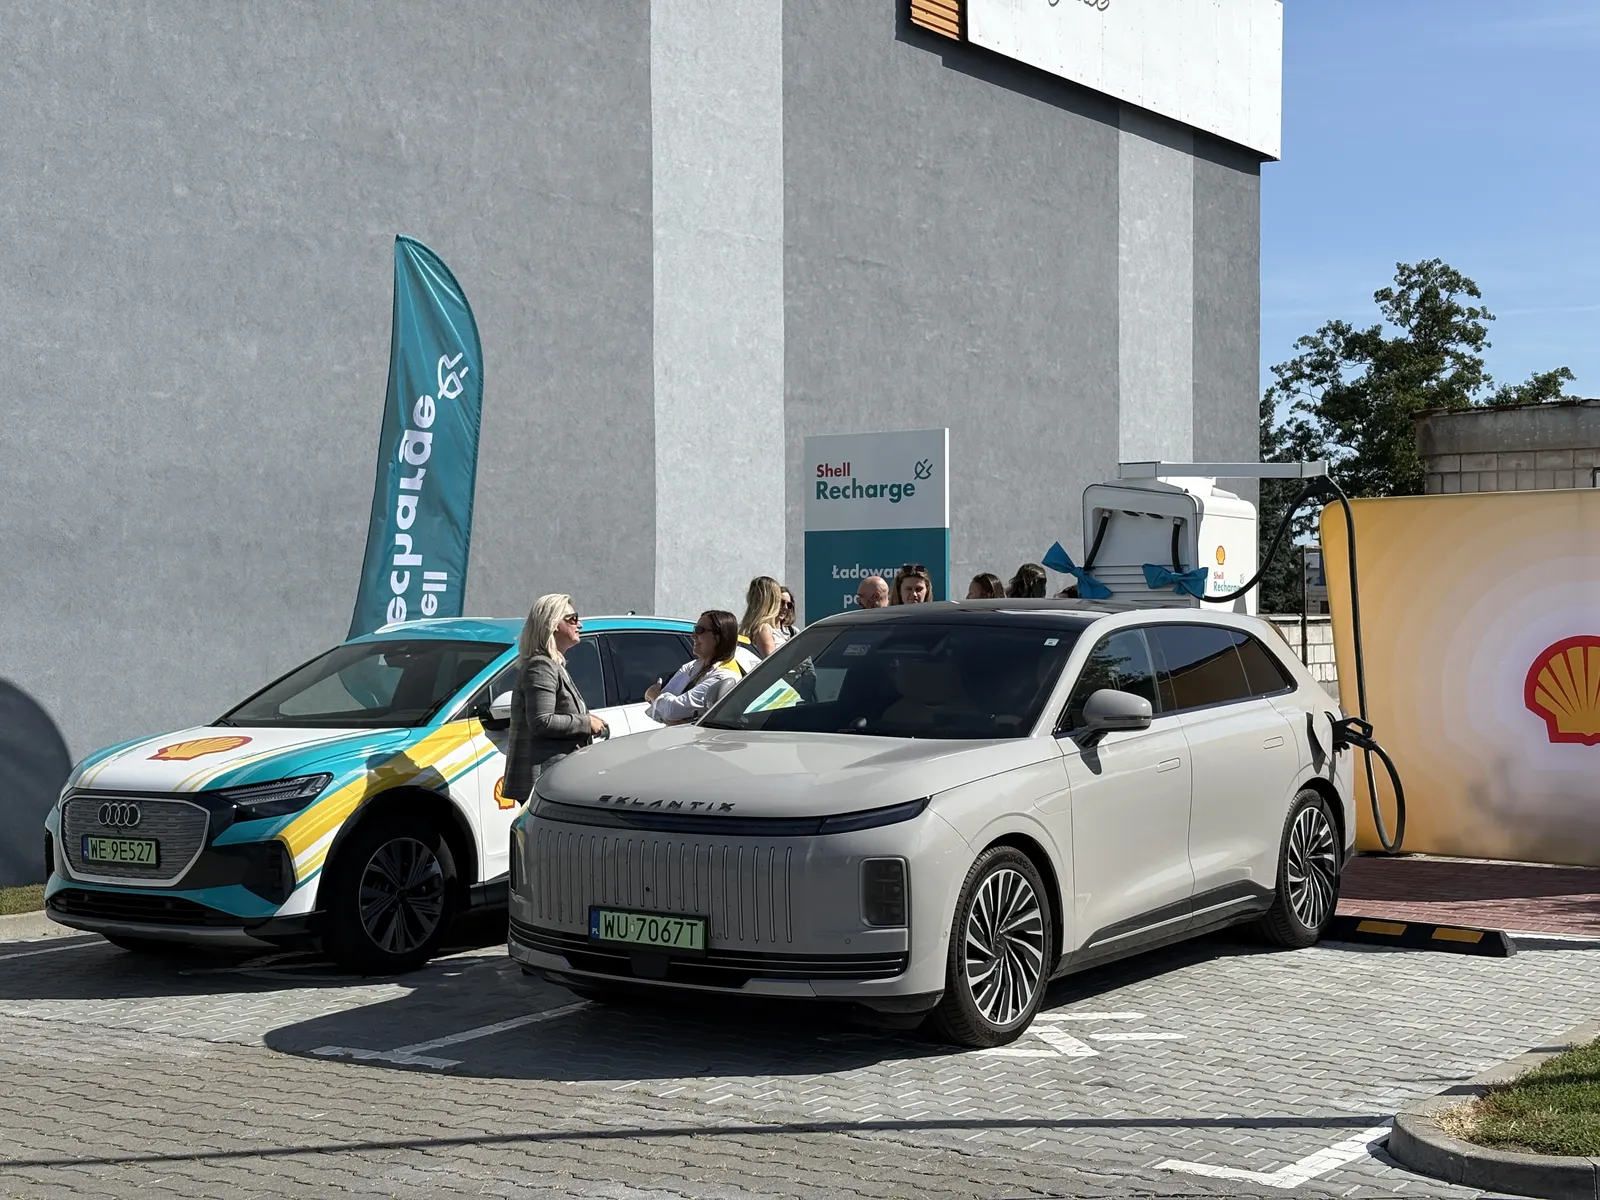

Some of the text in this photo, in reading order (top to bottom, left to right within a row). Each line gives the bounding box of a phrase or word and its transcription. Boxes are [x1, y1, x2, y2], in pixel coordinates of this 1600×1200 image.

[816, 462, 850, 477] Shell
[816, 478, 916, 503] Recharge
[832, 563, 901, 579] Ładowan
[91, 840, 153, 862] WE 9E527
[604, 914, 698, 946] WU 7067T
